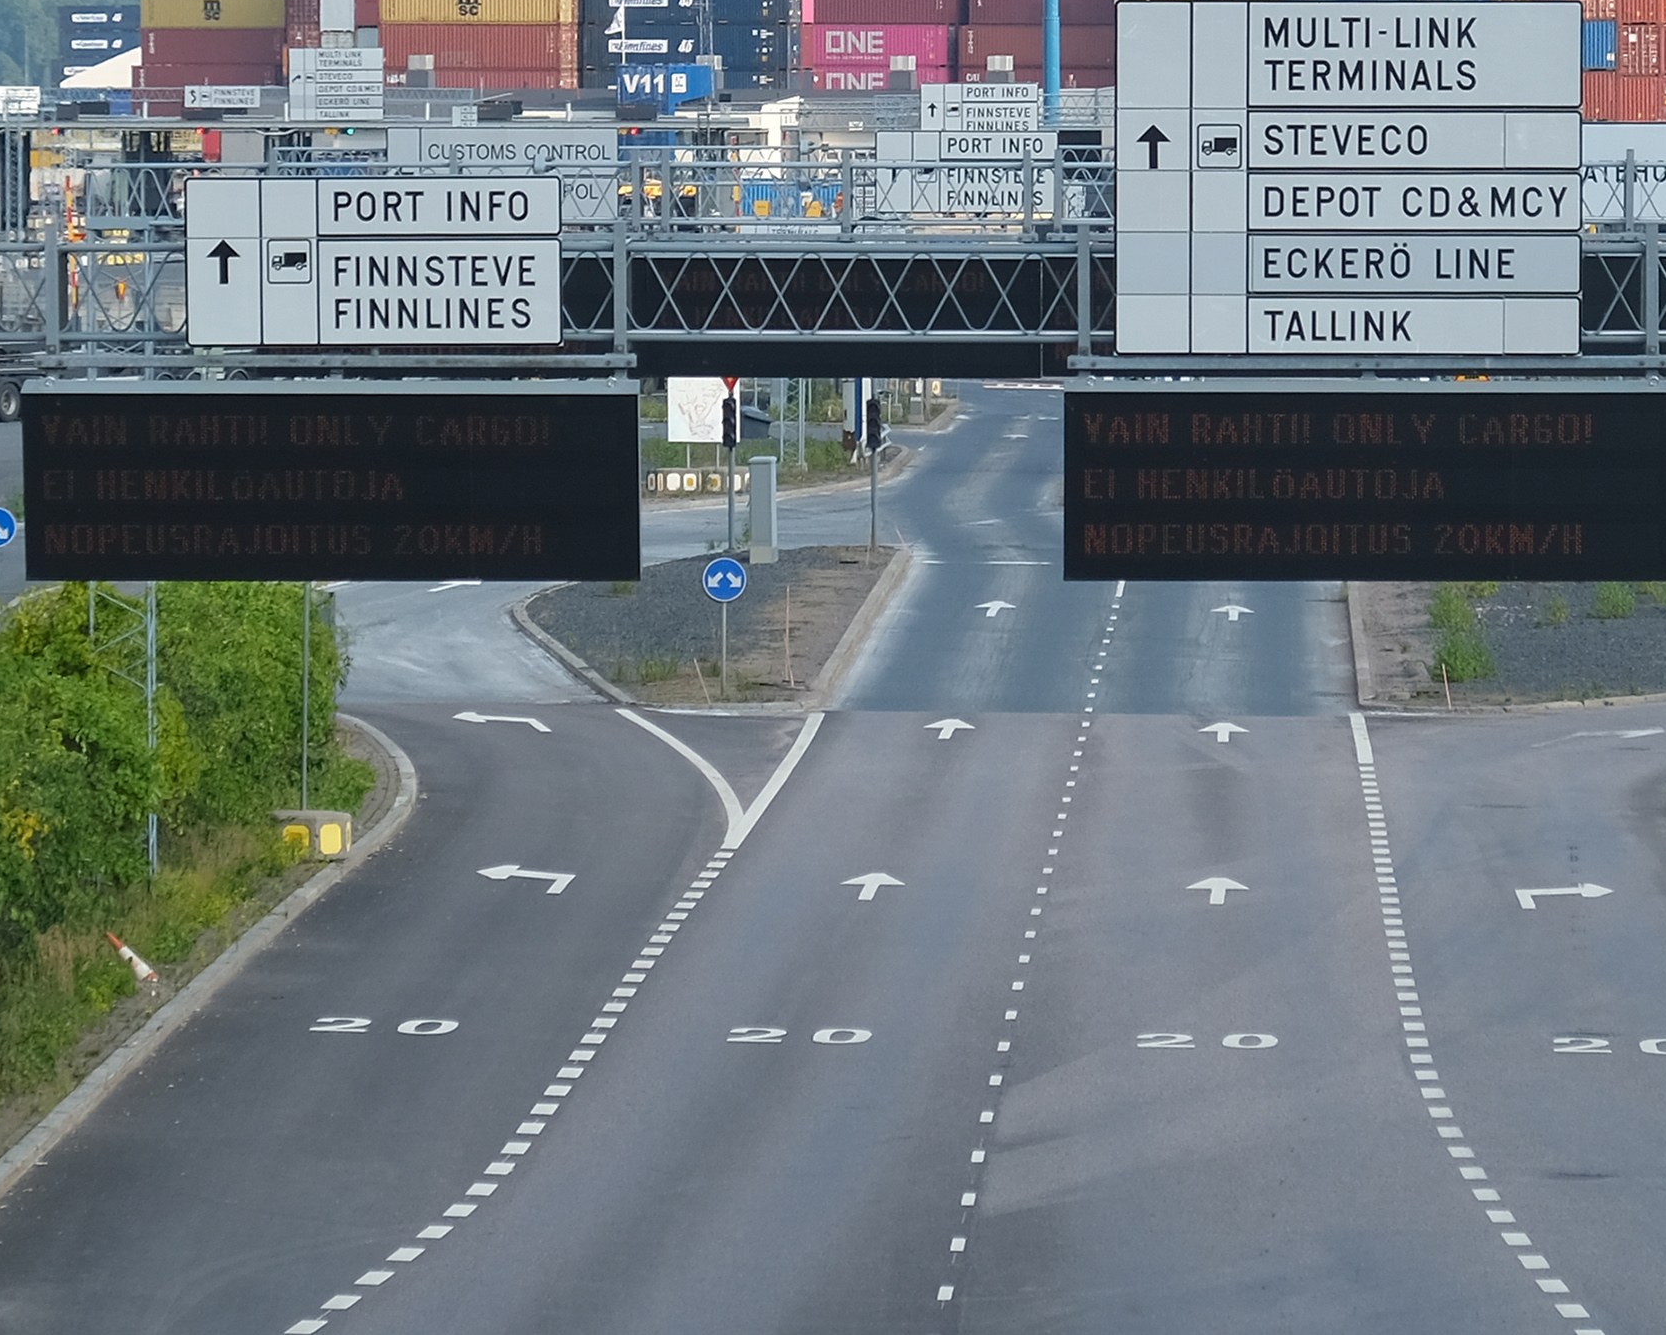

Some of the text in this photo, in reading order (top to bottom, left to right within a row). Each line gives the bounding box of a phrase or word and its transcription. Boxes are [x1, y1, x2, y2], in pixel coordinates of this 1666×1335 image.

[826, 31, 883, 53] ONE
[1265, 18, 1475, 48] MULTI-LINK
[622, 73, 664, 93] V11
[1265, 60, 1476, 90] TERMINALS
[967, 87, 1028, 97] PORT INFO
[967, 107, 1030, 117] FINNSTEVE
[967, 121, 1029, 131] FINNLINES
[428, 144, 611, 160] CUSTOMS CONTROL
[947, 138, 1043, 153] PORT INFO
[1265, 125, 1427, 155] STEVECO
[334, 191, 528, 221] PORT INFO
[1265, 187, 1566, 217] DEPOT CD&MCY
[335, 256, 535, 286] FINNSTEVE
[1265, 242, 1514, 279] ECKERÖ LINE
[335, 298, 530, 328] FINNLINES
[1264, 311, 1410, 341] TALLINK
[41, 415, 126, 445] VAIN
[290, 415, 392, 445] ONLY
[1084, 414, 1169, 444] VAIN
[1333, 414, 1436, 444] ONLY
[1459, 414, 1593, 444] CARGO!
[43, 470, 75, 500] EI
[1084, 469, 1116, 499] EI
[44, 524, 543, 555] NOPEUSRAJOITUS 20KM/H
[1084, 524, 1583, 554] NOPEUSRAJOITUS 20KM/H
[310, 1017, 458, 1035] 20
[727, 1027, 872, 1044] 20
[1136, 1033, 1278, 1049] 20
